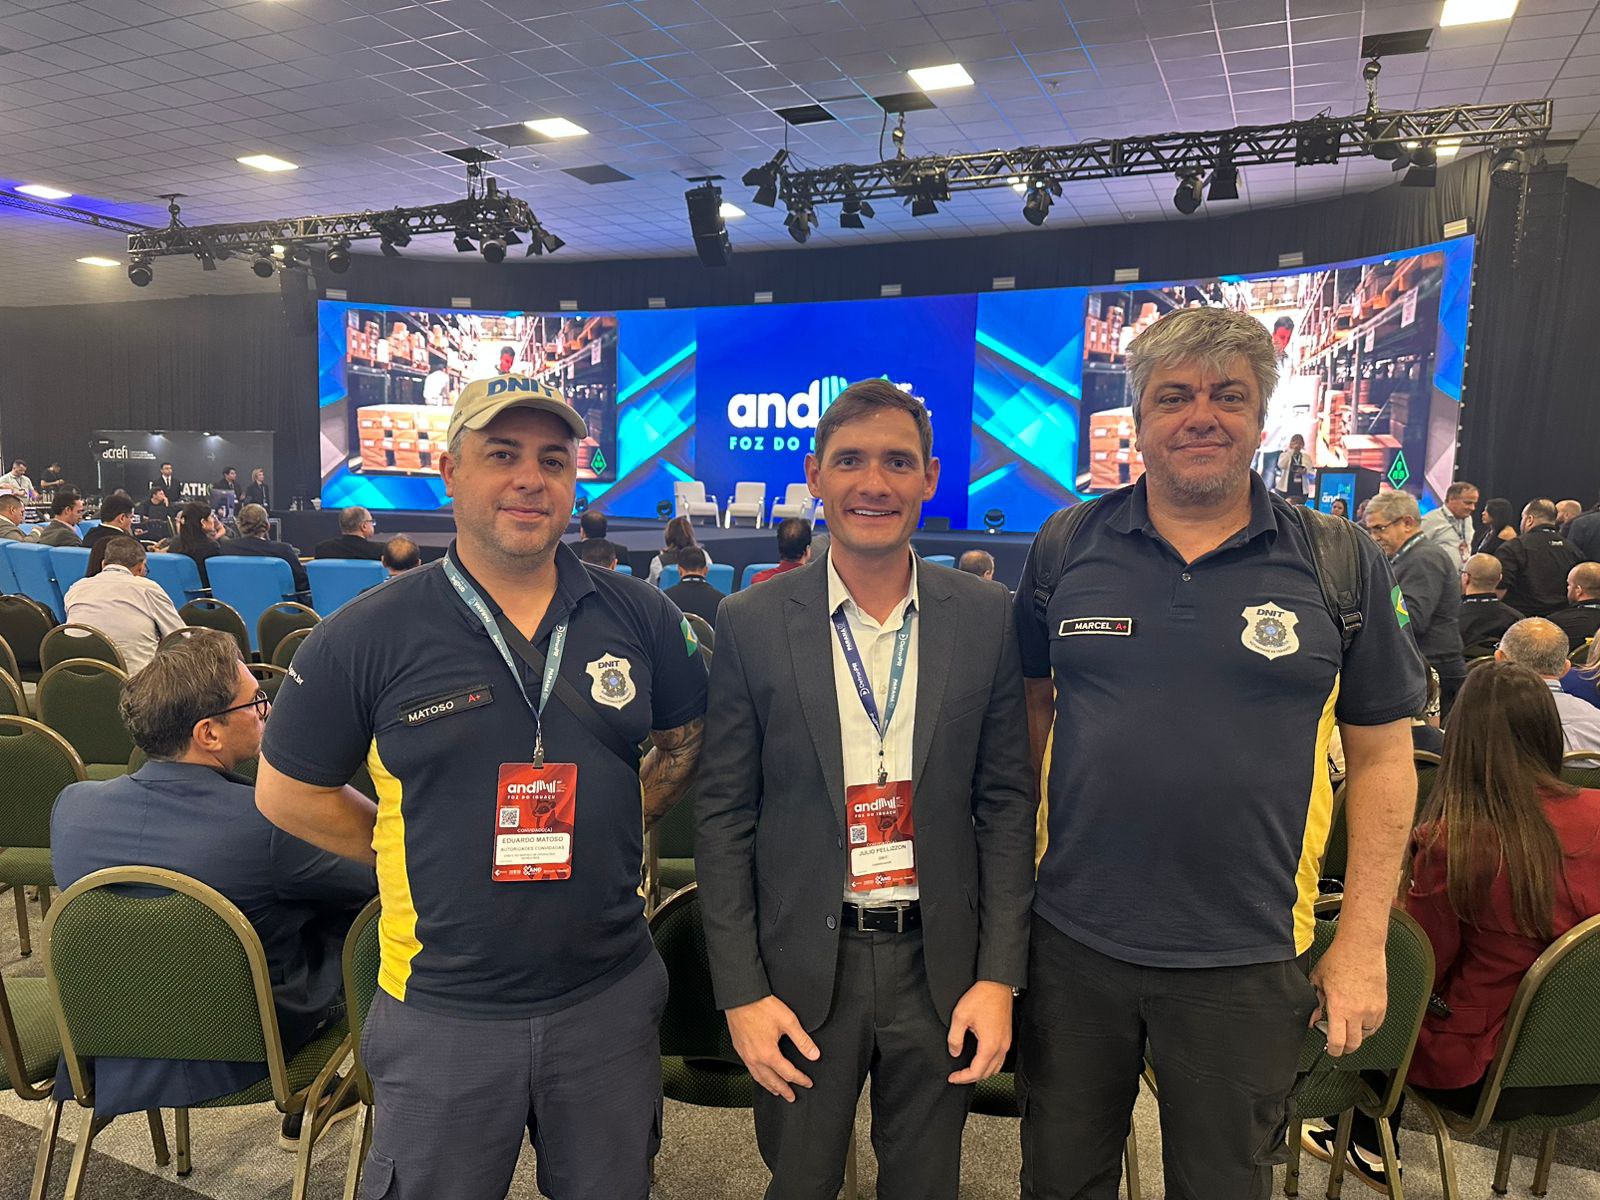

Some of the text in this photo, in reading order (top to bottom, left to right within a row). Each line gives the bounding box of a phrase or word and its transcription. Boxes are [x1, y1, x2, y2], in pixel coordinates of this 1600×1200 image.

[487, 377, 554, 397] DNIT
[729, 436, 765, 451] FOZ
[773, 436, 800, 451] DO
[1256, 609, 1285, 617] DNIT
[1074, 621, 1112, 630] MARCEL
[598, 660, 620, 669] DNIT
[408, 701, 454, 722] MATOSO
